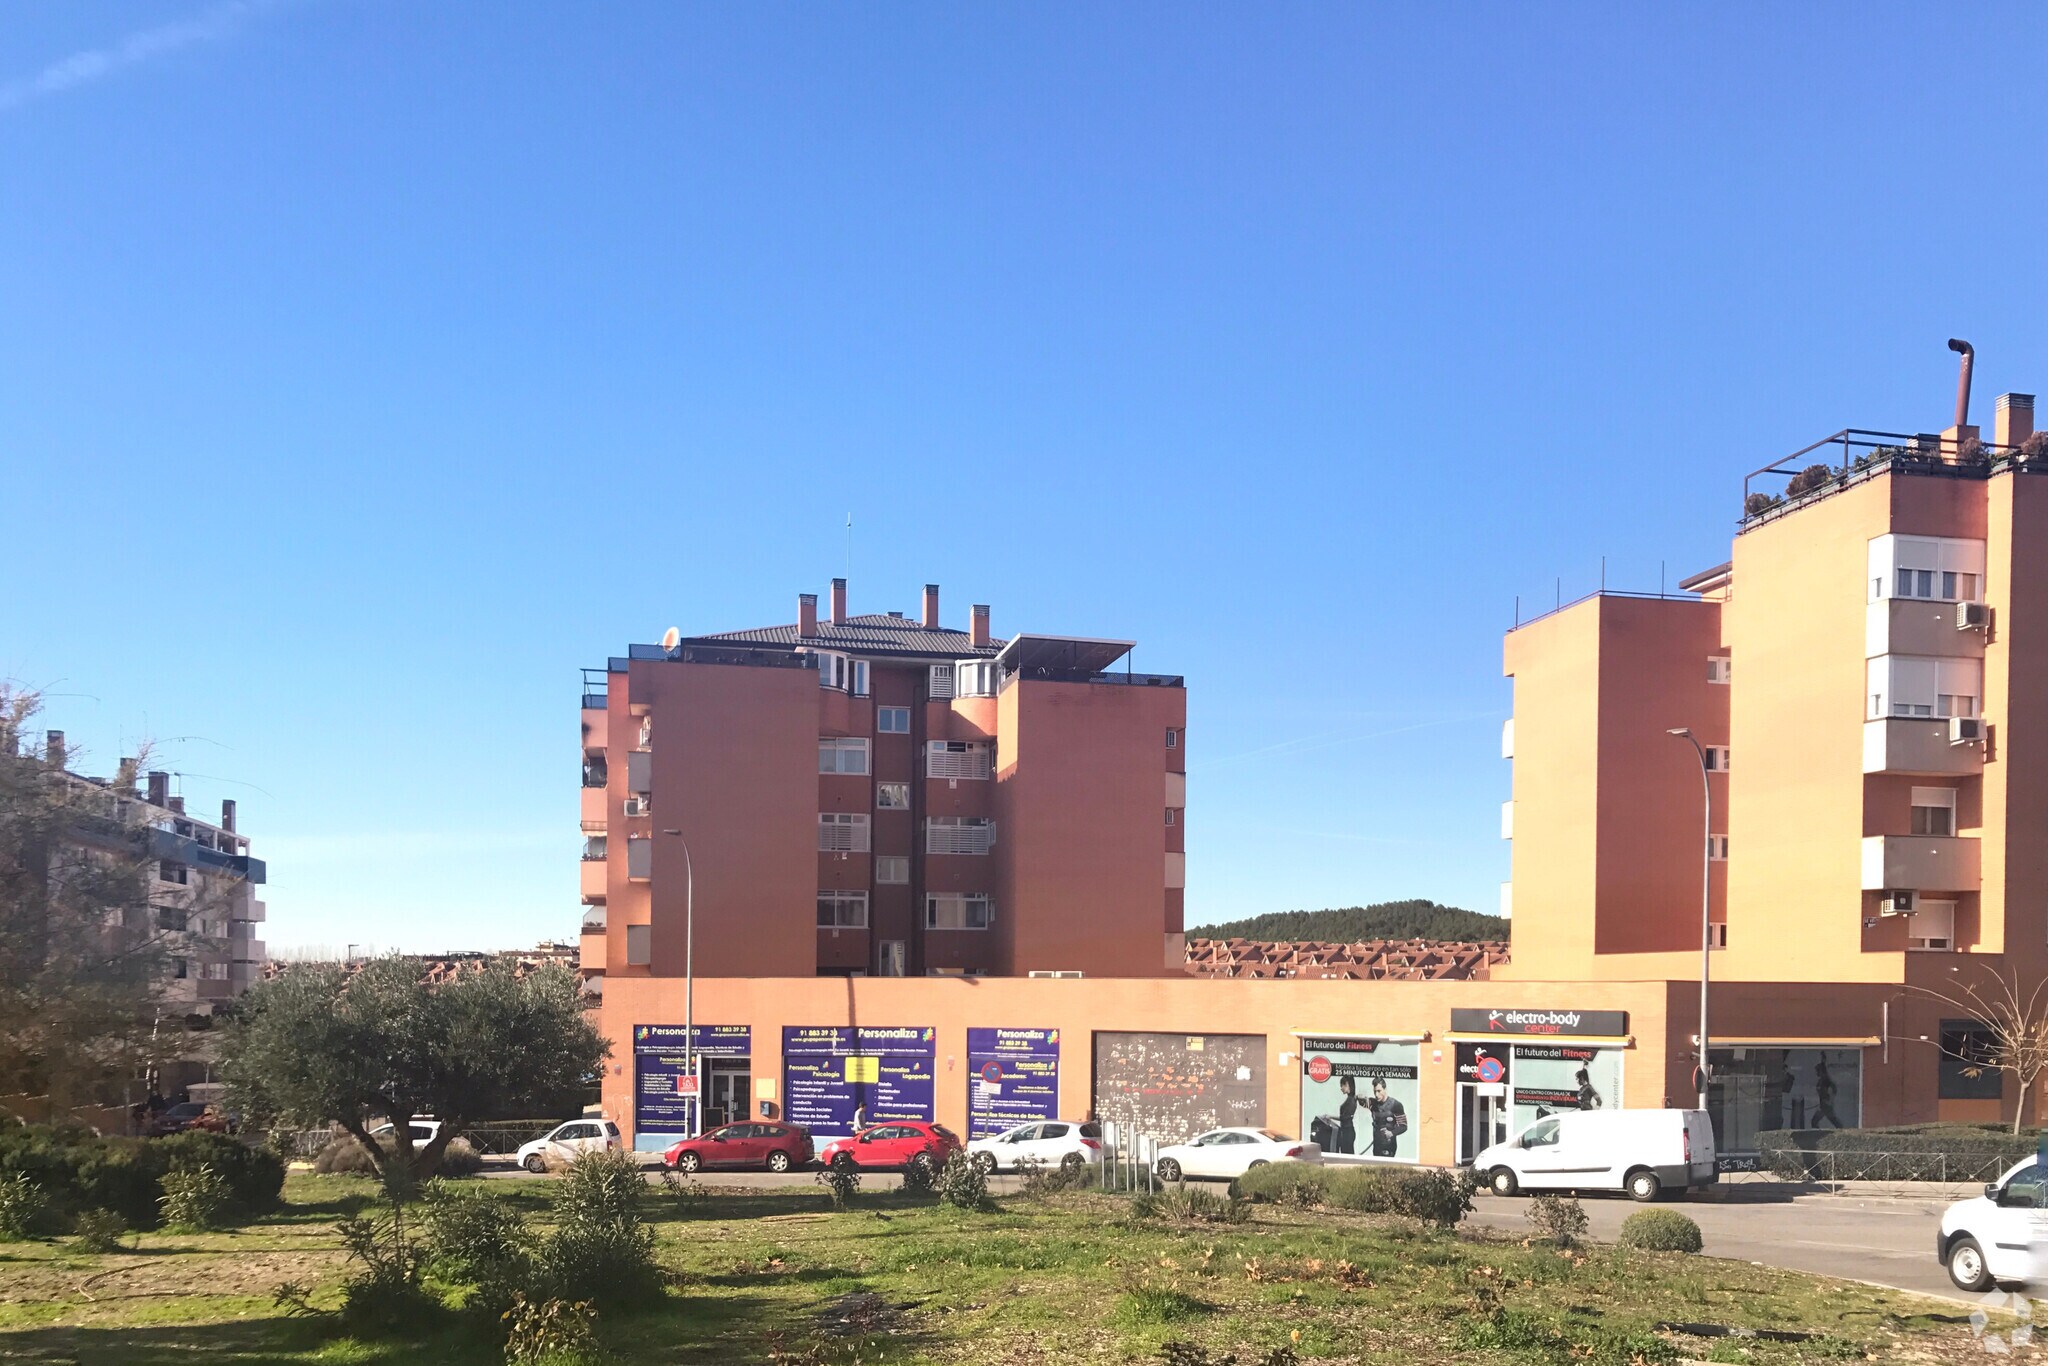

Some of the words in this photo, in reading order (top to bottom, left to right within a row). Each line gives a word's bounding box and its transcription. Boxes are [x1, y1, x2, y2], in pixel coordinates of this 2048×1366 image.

[1506, 1011, 1580, 1027] electro-body
[652, 1027, 700, 1036] Personaza
[858, 1028, 918, 1038] Personaliza
[1525, 1024, 1561, 1033] center
[997, 1029, 1044, 1038] Personaliza
[1562, 1050, 1591, 1058] Fitness
